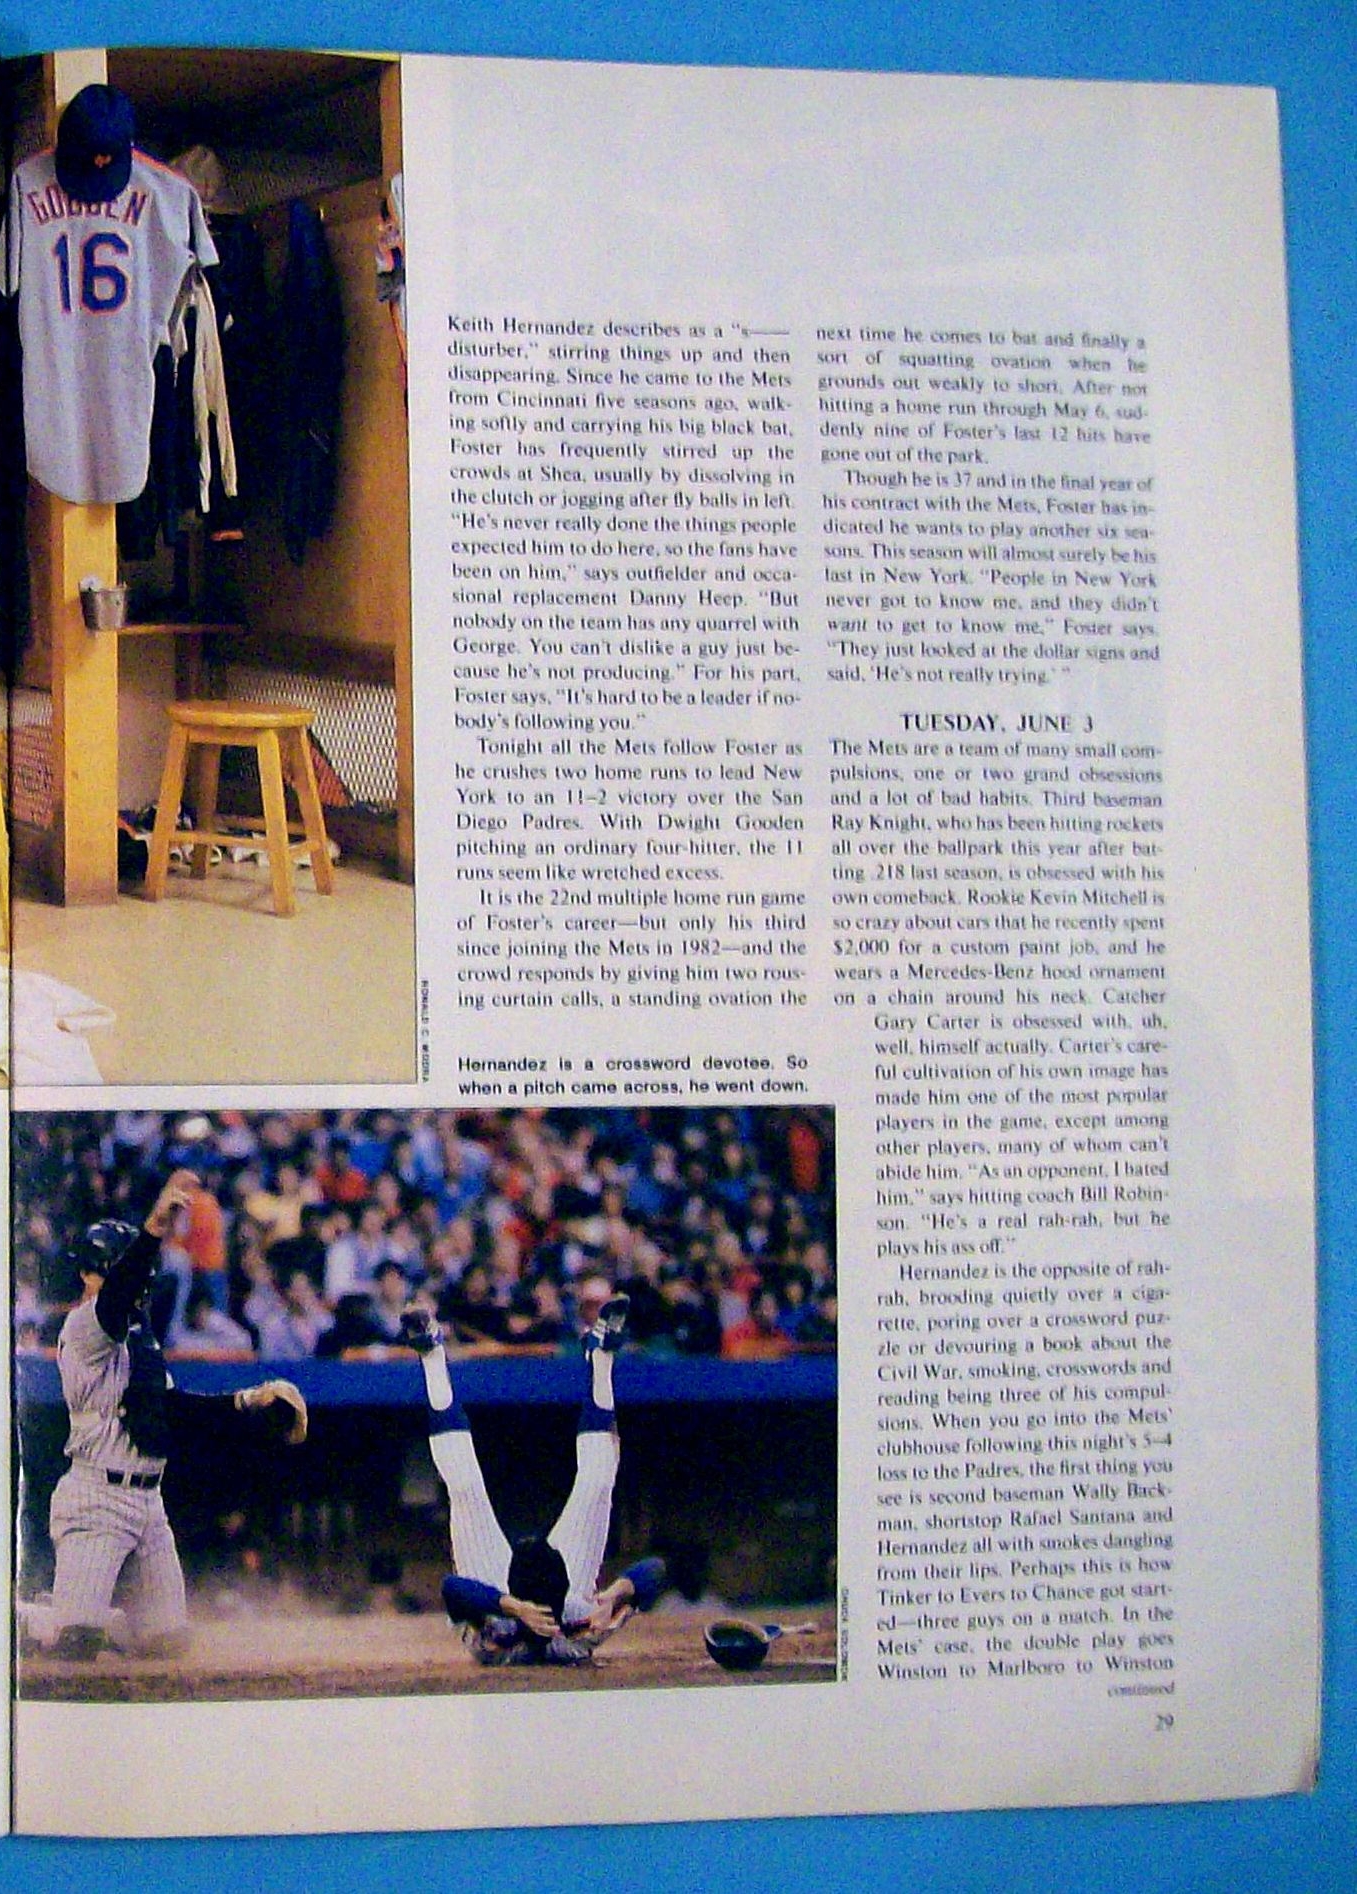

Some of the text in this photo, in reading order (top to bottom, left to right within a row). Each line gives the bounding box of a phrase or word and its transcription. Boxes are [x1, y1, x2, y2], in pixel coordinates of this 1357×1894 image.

[53, 231, 131, 317] 16
[1017, 714, 1071, 732] JUNE
[1085, 715, 1093, 732] 3
[456, 788, 495, 805] York
[508, 791, 524, 804] to
[534, 793, 554, 805] an
[618, 789, 676, 809] victory
[688, 793, 723, 805] over
[736, 789, 761, 805] the
[772, 788, 803, 805] San
[457, 813, 507, 832] Diego
[600, 812, 642, 831] With
[658, 814, 720, 833] Dwight
[736, 814, 803, 830] Gooden
[459, 1057, 546, 1072] Hernandez
[559, 1057, 572, 1071] is
[585, 1060, 593, 1071] a
[606, 1055, 690, 1070] crossword
[787, 1055, 808, 1069] So
[459, 1080, 501, 1095] when
[508, 1084, 517, 1094] a
[524, 1080, 565, 1097] pitch
[571, 1083, 617, 1094] came
[690, 1078, 709, 1093] he
[716, 1079, 754, 1093] went
[878, 1655, 1174, 1680] Winston to Marlboro to Winston
